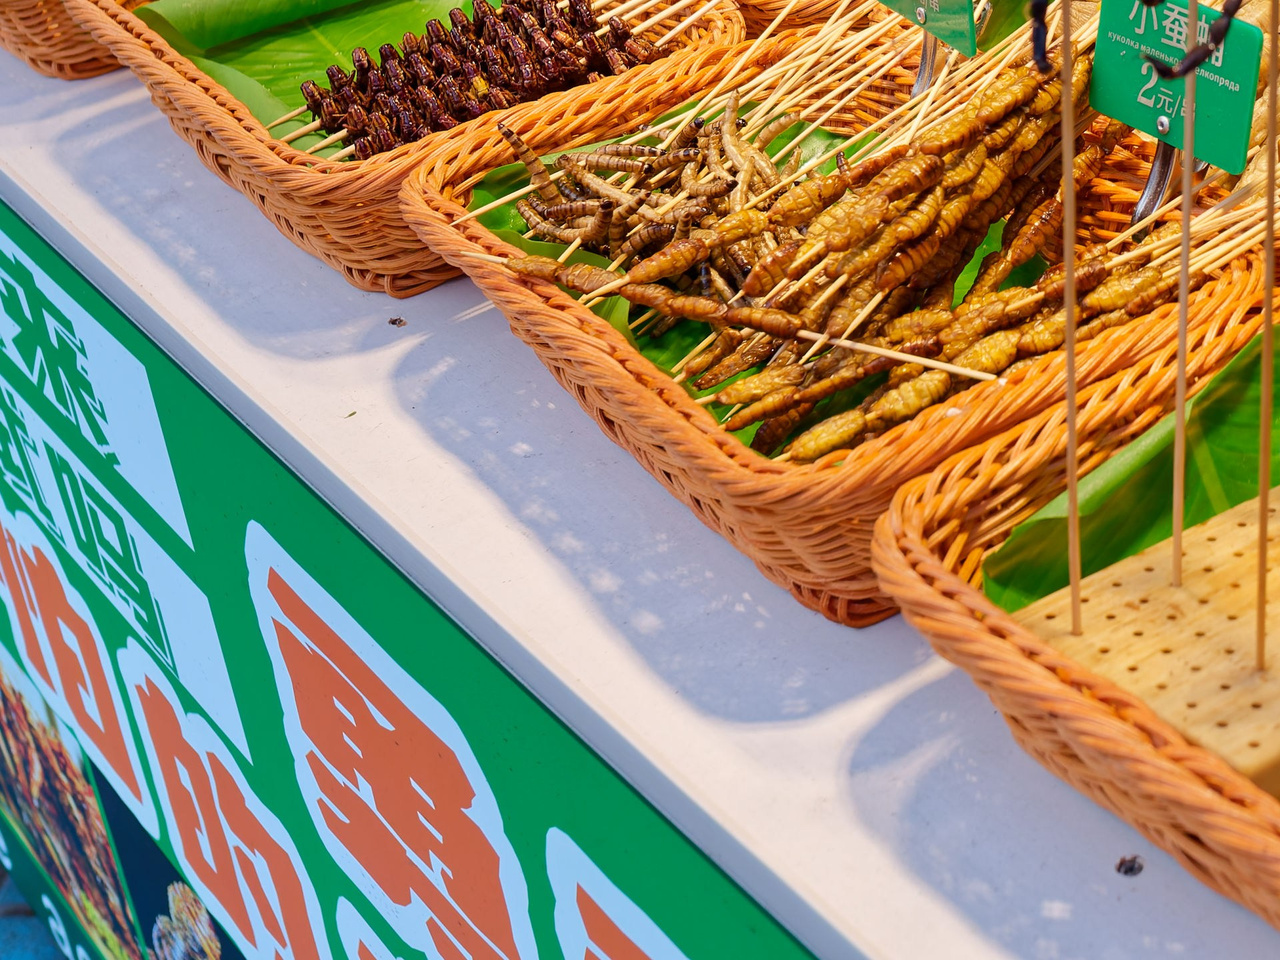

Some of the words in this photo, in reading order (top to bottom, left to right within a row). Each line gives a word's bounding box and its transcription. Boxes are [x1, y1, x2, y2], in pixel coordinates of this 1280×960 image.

[1107, 31, 1140, 50] куколка
[1140, 43, 1181, 67] маленько
[1194, 66, 1240, 92] елкопряда
